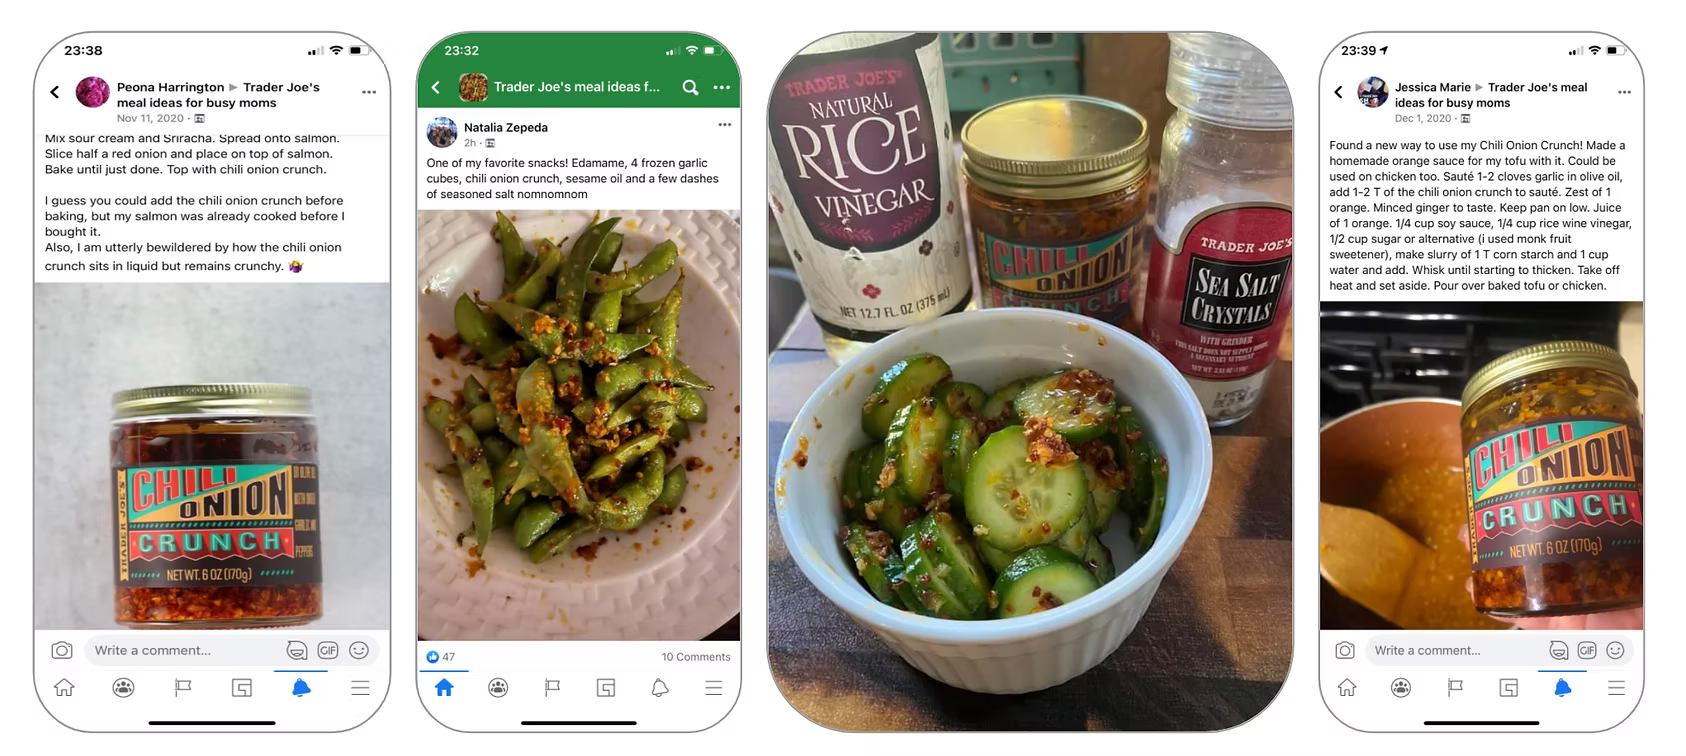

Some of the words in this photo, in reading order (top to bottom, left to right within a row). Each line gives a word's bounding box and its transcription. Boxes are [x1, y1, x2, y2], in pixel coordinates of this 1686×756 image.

[64, 45, 103, 56] 23:38
[445, 46, 478, 56] 23:32
[1341, 46, 1376, 56] 23:39
[118, 83, 154, 92] Peona
[159, 82, 224, 94] Harrington
[243, 82, 283, 92] Trader
[287, 83, 320, 92] Joe's
[494, 81, 534, 92] Trader
[538, 82, 571, 92] Joe's
[575, 81, 604, 92] meal
[608, 81, 640, 92] ideas
[784, 74, 849, 98] TRADER
[1395, 82, 1436, 92] Jessica
[1440, 82, 1471, 92] Marie
[1488, 82, 1525, 92] Trader
[1528, 83, 1558, 92] Joe's
[1561, 82, 1587, 92] meal
[118, 98, 146, 107] meal
[150, 98, 182, 107] ideas
[186, 98, 203, 107] for
[207, 98, 236, 109] busy
[808, 92, 893, 120] NATURAL
[1396, 98, 1424, 107] ideas
[1428, 98, 1444, 107] for
[1447, 98, 1473, 109] busy
[141, 114, 153, 124] 11,
[157, 114, 184, 122] 2020
[1396, 114, 1413, 122] Dec
[1417, 114, 1423, 124] 1,
[1427, 114, 1451, 122] 2020
[465, 122, 502, 132] Natalia
[506, 123, 548, 134] Zepeda
[464, 139, 476, 147] 2h
[782, 105, 926, 193] RICE
[427, 158, 448, 167] One
[452, 158, 462, 167] of
[466, 160, 481, 169] my
[485, 158, 524, 167] favorite
[528, 158, 568, 167] snacks!
[572, 158, 627, 169] Edamame,
[631, 158, 638, 167] 4
[642, 158, 675, 167] frozen
[678, 158, 707, 169] garlic
[46, 165, 73, 174] Bake
[77, 164, 102, 174] until
[105, 165, 126, 176] just
[130, 165, 162, 174] done.
[167, 165, 188, 176] Top
[192, 165, 216, 174] with
[220, 165, 243, 174] chili
[247, 165, 279, 174] onion
[283, 165, 326, 174] crunch.
[427, 174, 461, 185] cubes,
[466, 174, 486, 183] chili
[490, 174, 519, 183] onion
[522, 174, 562, 185] crunch,
[610, 174, 622, 183] oil
[626, 174, 645, 183] and
[658, 174, 677, 183] few
[680, 174, 718, 183] dashes
[1330, 172, 1355, 181] used
[1375, 172, 1416, 181] chicken
[1420, 172, 1439, 181] too.
[1444, 171, 1474, 181] Sauté
[1478, 172, 1494, 181] 1-2
[1498, 172, 1532, 181] cloves
[1535, 172, 1564, 183] garlic
[1568, 172, 1576, 181] in
[1580, 172, 1604, 181] olive
[1608, 172, 1622, 182] oil,
[427, 189, 437, 198] of
[441, 189, 492, 198] seasoned
[496, 190, 514, 198] salt
[814, 178, 934, 218] VINEGAR
[1201, 237, 1254, 253] TRADER
[992, 240, 1088, 276] CHILI
[1037, 232, 1130, 292] ONION
[45, 262, 85, 270] crunch
[89, 261, 109, 270] sits
[113, 261, 122, 270] in
[127, 261, 158, 272] liquid
[162, 262, 180, 270] but
[185, 261, 230, 270] remains
[234, 262, 284, 272] crunchy.
[1196, 268, 1228, 297] SEA
[1235, 273, 1280, 298] SALT
[1330, 281, 1352, 290] heat
[1356, 281, 1376, 290] and
[1380, 282, 1395, 290] set
[1399, 281, 1430, 290] aside.
[1434, 281, 1458, 290] Pour
[1488, 281, 1520, 290] baked
[1524, 281, 1545, 290] tofu
[1562, 281, 1606, 290] chicken.
[840, 306, 857, 318] NET
[860, 308, 881, 319] 12.7
[884, 306, 898, 318] FL.
[901, 303, 913, 315] OZ
[916, 295, 936, 312] (375
[1192, 296, 1272, 325] CRYSTALS
[1474, 423, 1574, 491] CHILI
[1517, 430, 1631, 488] ONION
[133, 466, 237, 512] CHILI
[180, 470, 289, 520] ONION
[1483, 494, 1628, 532] CRUNCH
[138, 531, 280, 552] CRUNCH
[1510, 544, 1526, 559] NET
[1527, 541, 1545, 558] WT.
[1547, 540, 1553, 555] 6
[1555, 539, 1569, 554] OZ
[1570, 536, 1603, 555] (170g)
[167, 570, 183, 581] NET
[184, 569, 200, 580] WT.
[202, 569, 209, 580] 6
[211, 568, 222, 580] OZ
[224, 568, 252, 583] (170g)
[95, 645, 127, 655] Write
[142, 646, 210, 655] comment...
[320, 646, 336, 656] GIF
[1375, 645, 1404, 655] Write
[1418, 646, 1480, 655] comment...
[1580, 646, 1594, 655] GIF
[442, 653, 455, 661] 47
[662, 652, 673, 661] 10
[676, 652, 730, 661] Comments
